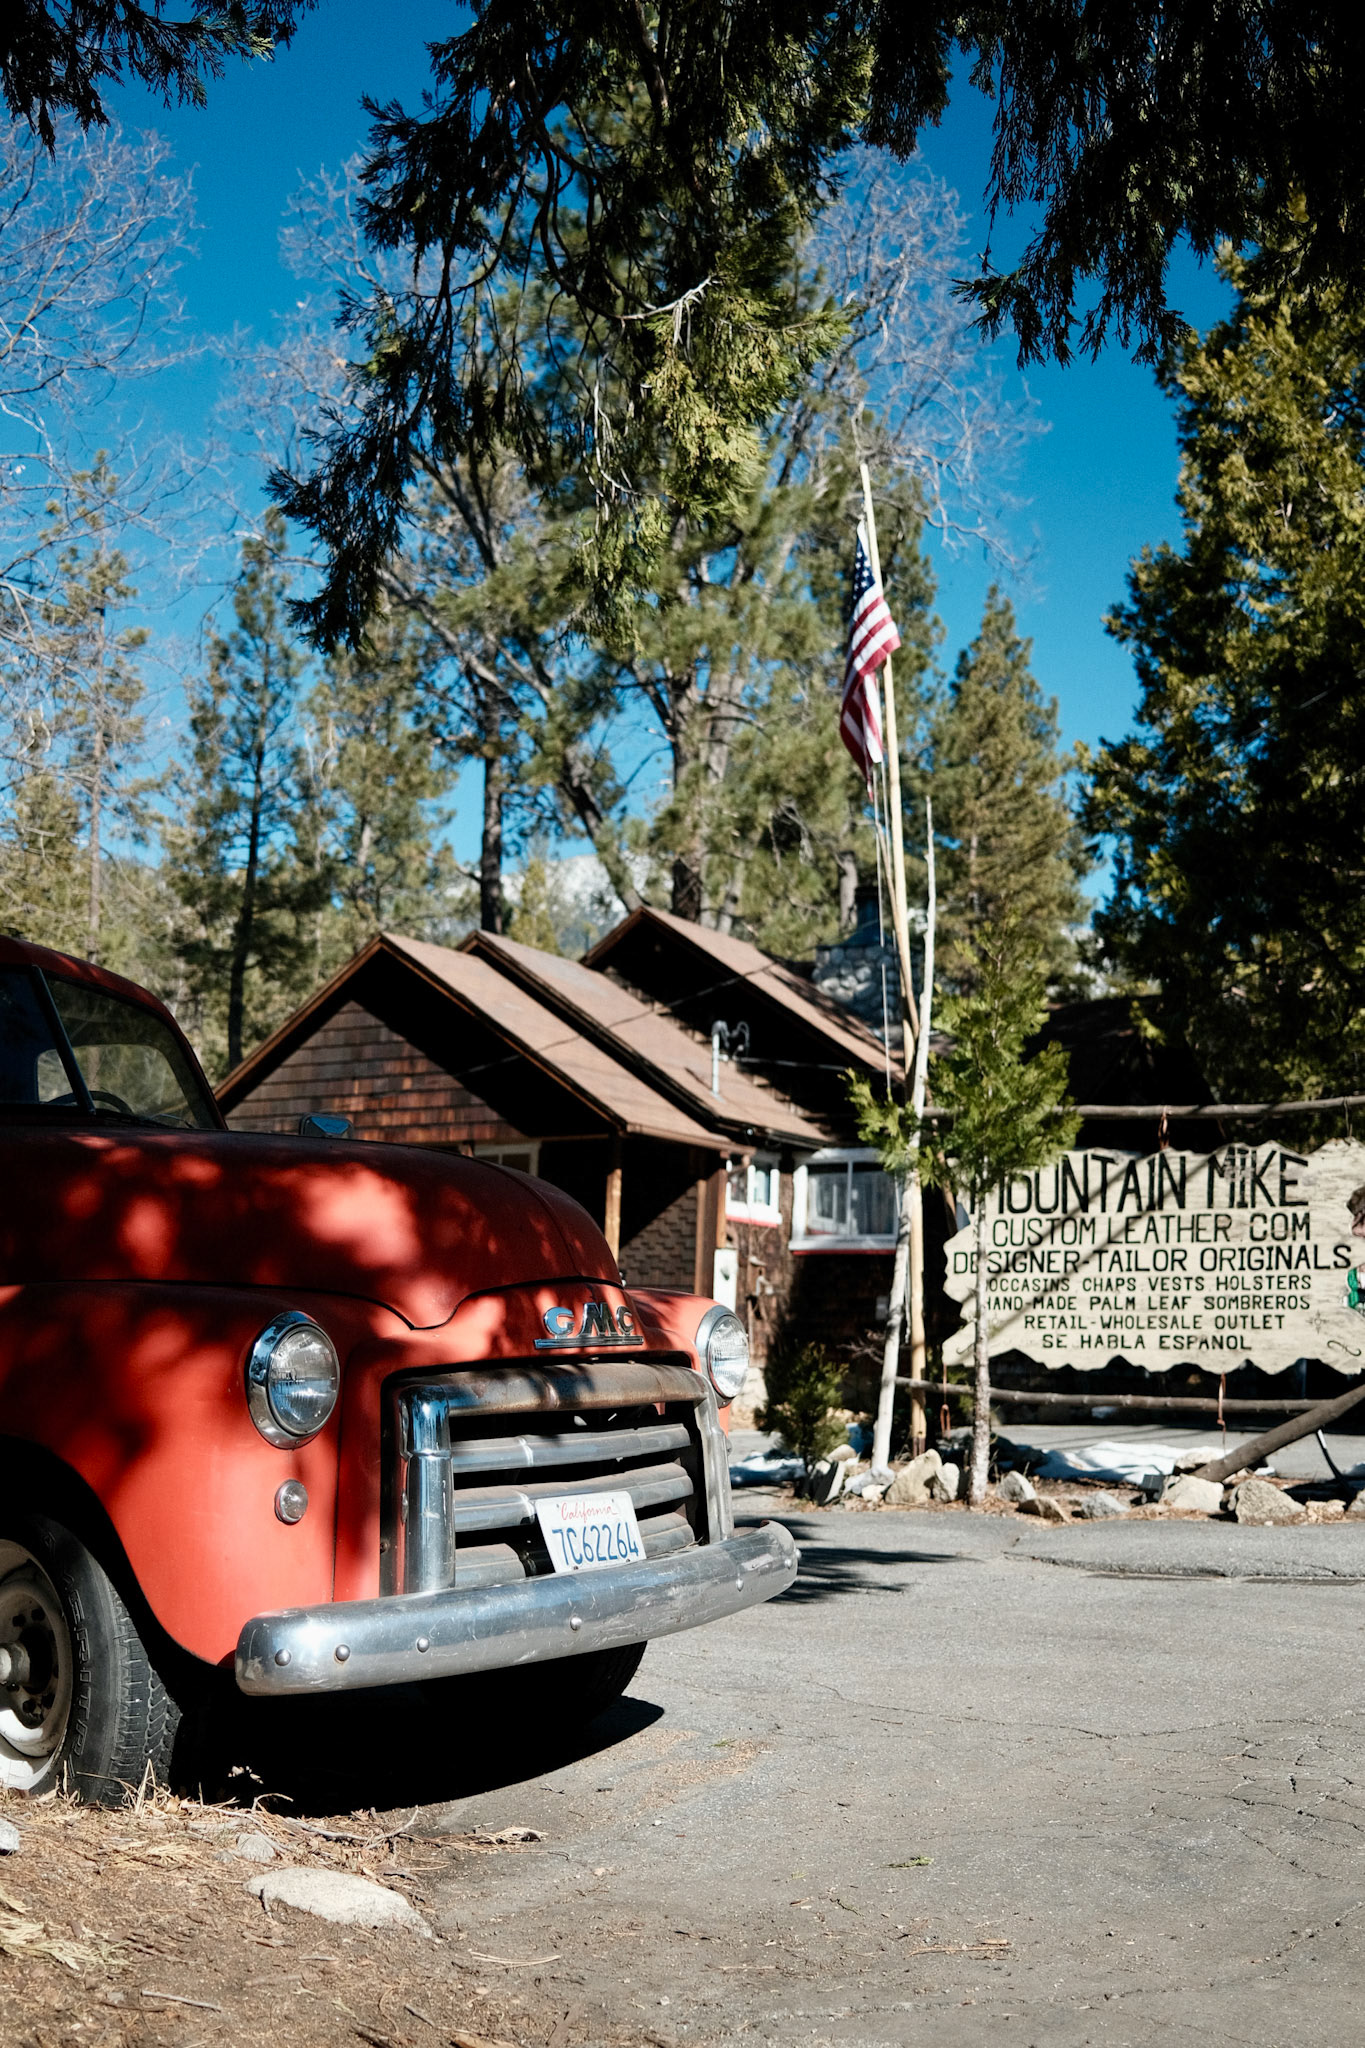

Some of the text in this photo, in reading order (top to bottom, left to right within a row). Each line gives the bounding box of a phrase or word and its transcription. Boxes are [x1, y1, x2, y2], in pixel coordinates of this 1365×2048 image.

[1207, 1147, 1309, 1209] MIKE
[993, 1211, 1311, 1247] CUSTOM LEATHER COM
[1199, 1244, 1352, 1273] ORIGINALS
[986, 1274, 1312, 1293] OCCASINS CHAPS VESTS HOLSTERS
[1090, 1295, 1136, 1311] PALM
[1148, 1295, 1192, 1311] LEAF
[1204, 1294, 1311, 1311] SOMBREROS
[544, 1301, 636, 1337] GMC
[1214, 1314, 1286, 1330] OUTLET
[1042, 1334, 1252, 1350] SE HABLA ESPANOL
[560, 1502, 618, 1524] California
[552, 1522, 639, 1566] 7C62264
